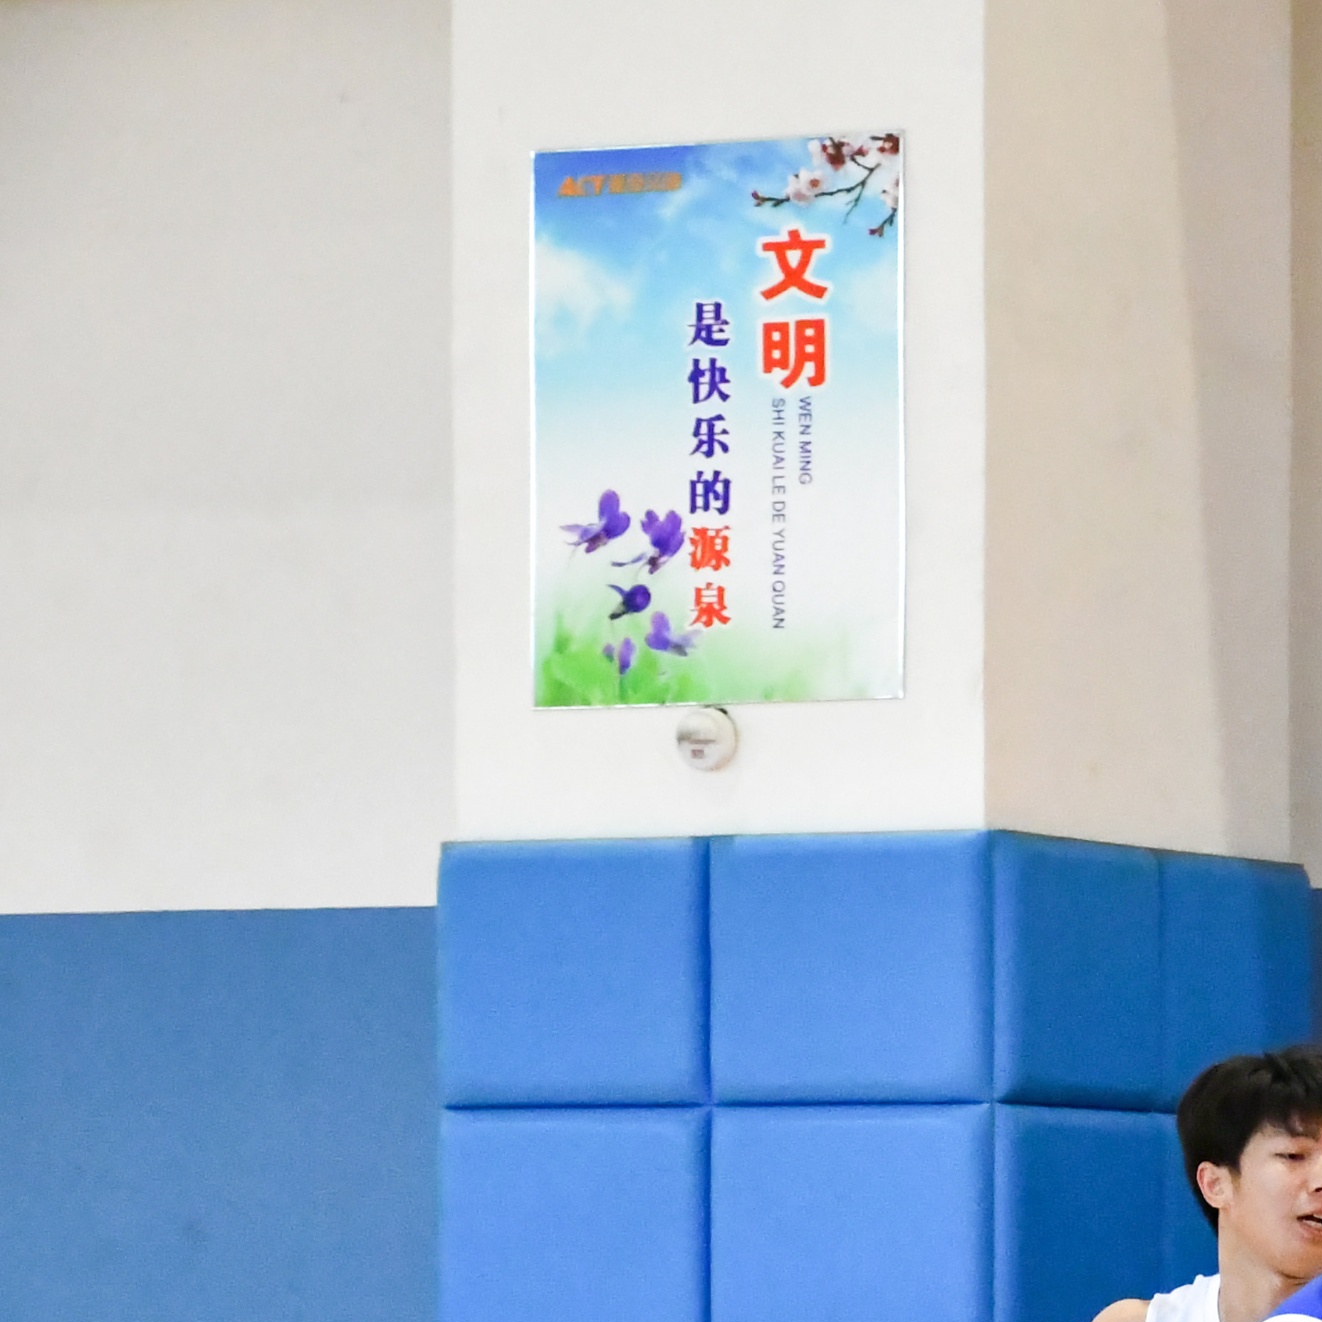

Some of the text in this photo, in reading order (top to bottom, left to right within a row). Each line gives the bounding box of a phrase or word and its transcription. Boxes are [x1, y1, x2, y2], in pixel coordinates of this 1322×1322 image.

[760, 228, 828, 389] 文明
[687, 301, 732, 629] 是快乐的源泉
[771, 398, 786, 629] SHI KUAI LE DE YUAN QUAN
[798, 396, 813, 486] WEN MING
